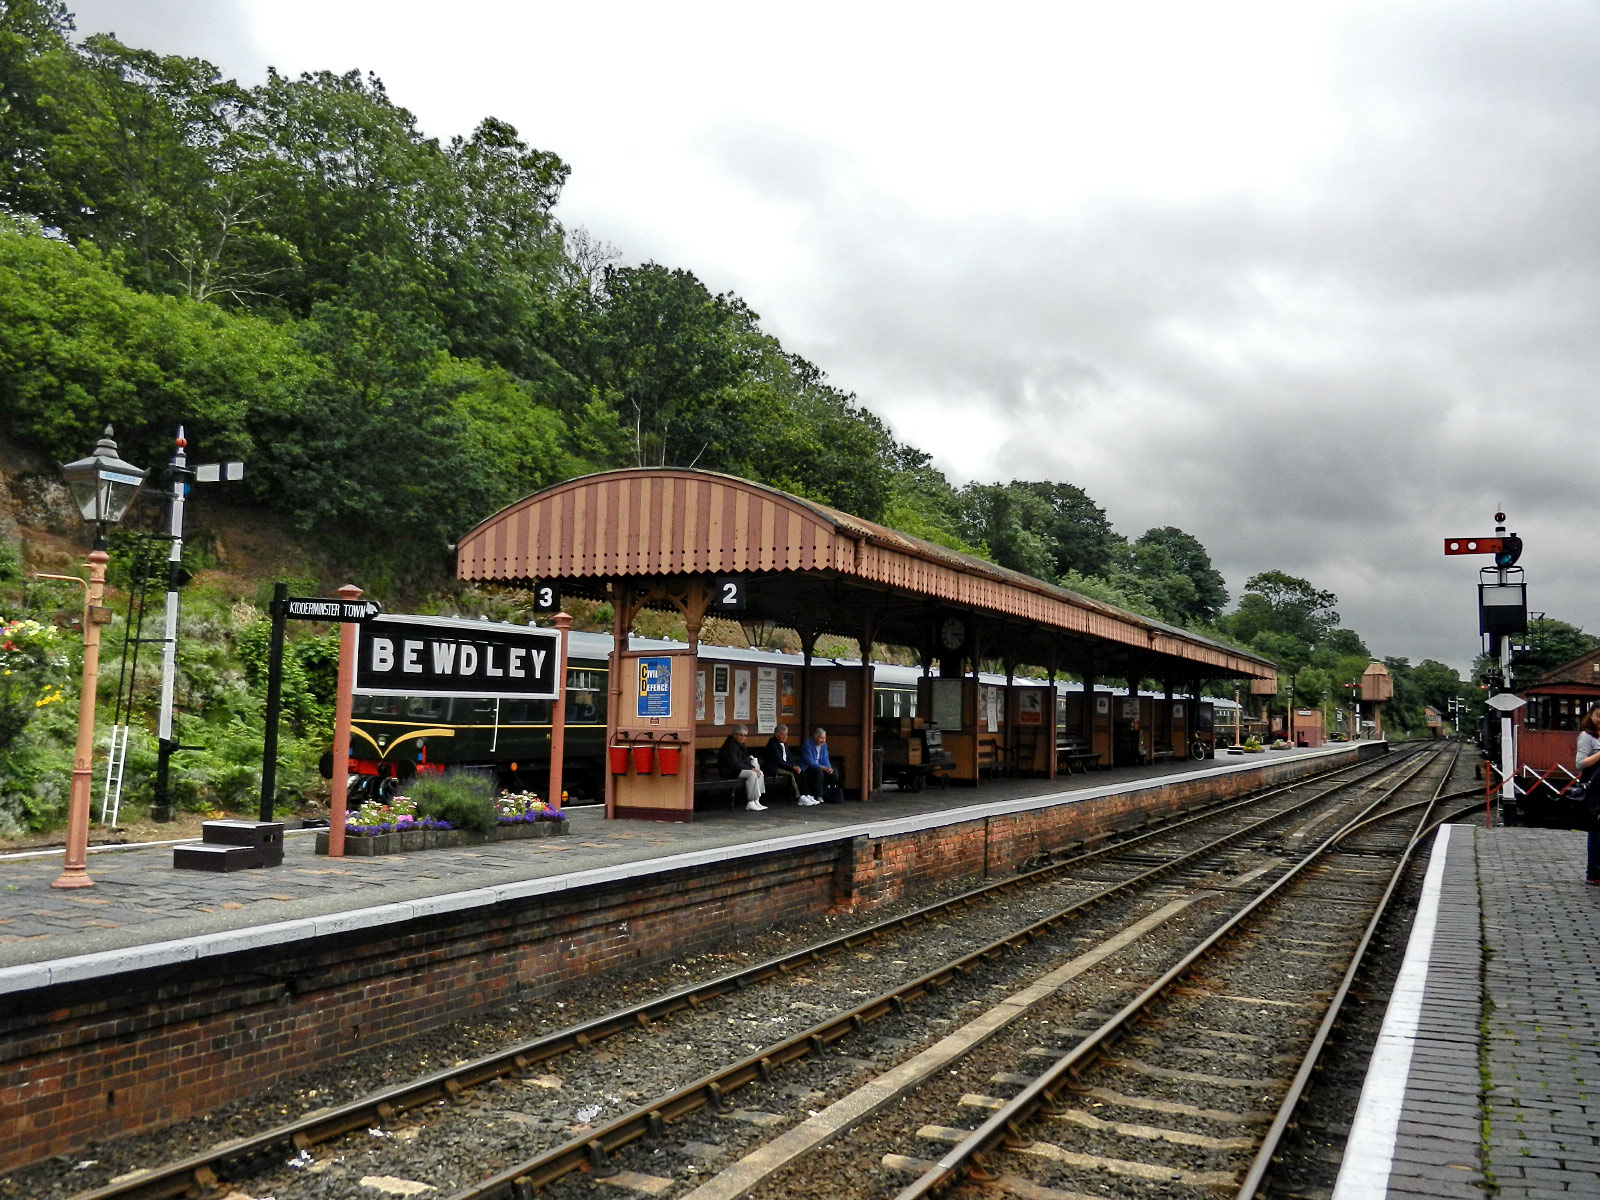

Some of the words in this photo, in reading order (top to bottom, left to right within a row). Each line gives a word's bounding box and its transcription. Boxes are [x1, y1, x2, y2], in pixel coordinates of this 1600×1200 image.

[539, 587, 553, 608] 3
[722, 583, 737, 604] 2
[289, 601, 341, 617] KIDDERMINSTER
[343, 604, 366, 618] TOWN
[372, 637, 547, 679] BEWDLEY
[641, 679, 668, 692] DEFENCE
